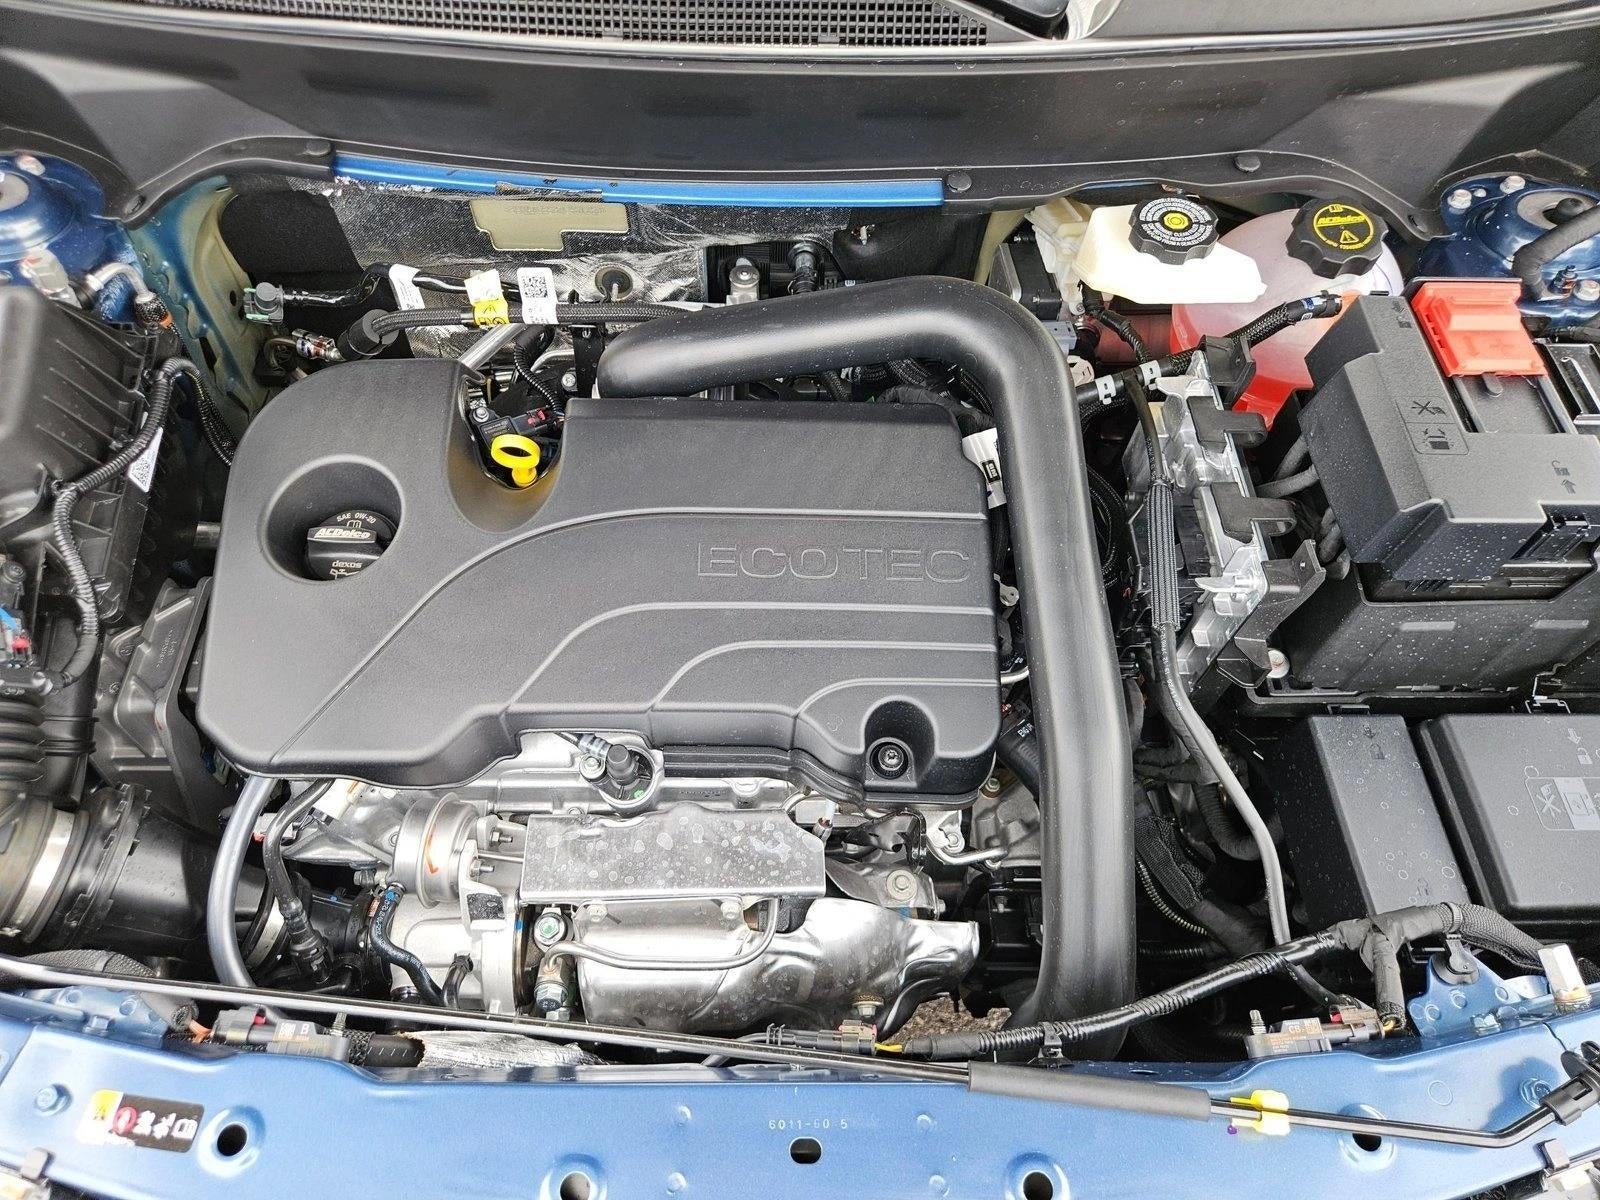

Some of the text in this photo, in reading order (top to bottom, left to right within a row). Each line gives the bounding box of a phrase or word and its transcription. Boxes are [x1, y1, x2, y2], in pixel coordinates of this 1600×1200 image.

[336, 512, 376, 524] SAE 0W-20
[314, 527, 371, 539] ACDelco
[332, 560, 362, 568] dexos
[697, 546, 970, 583] ECOTEC
